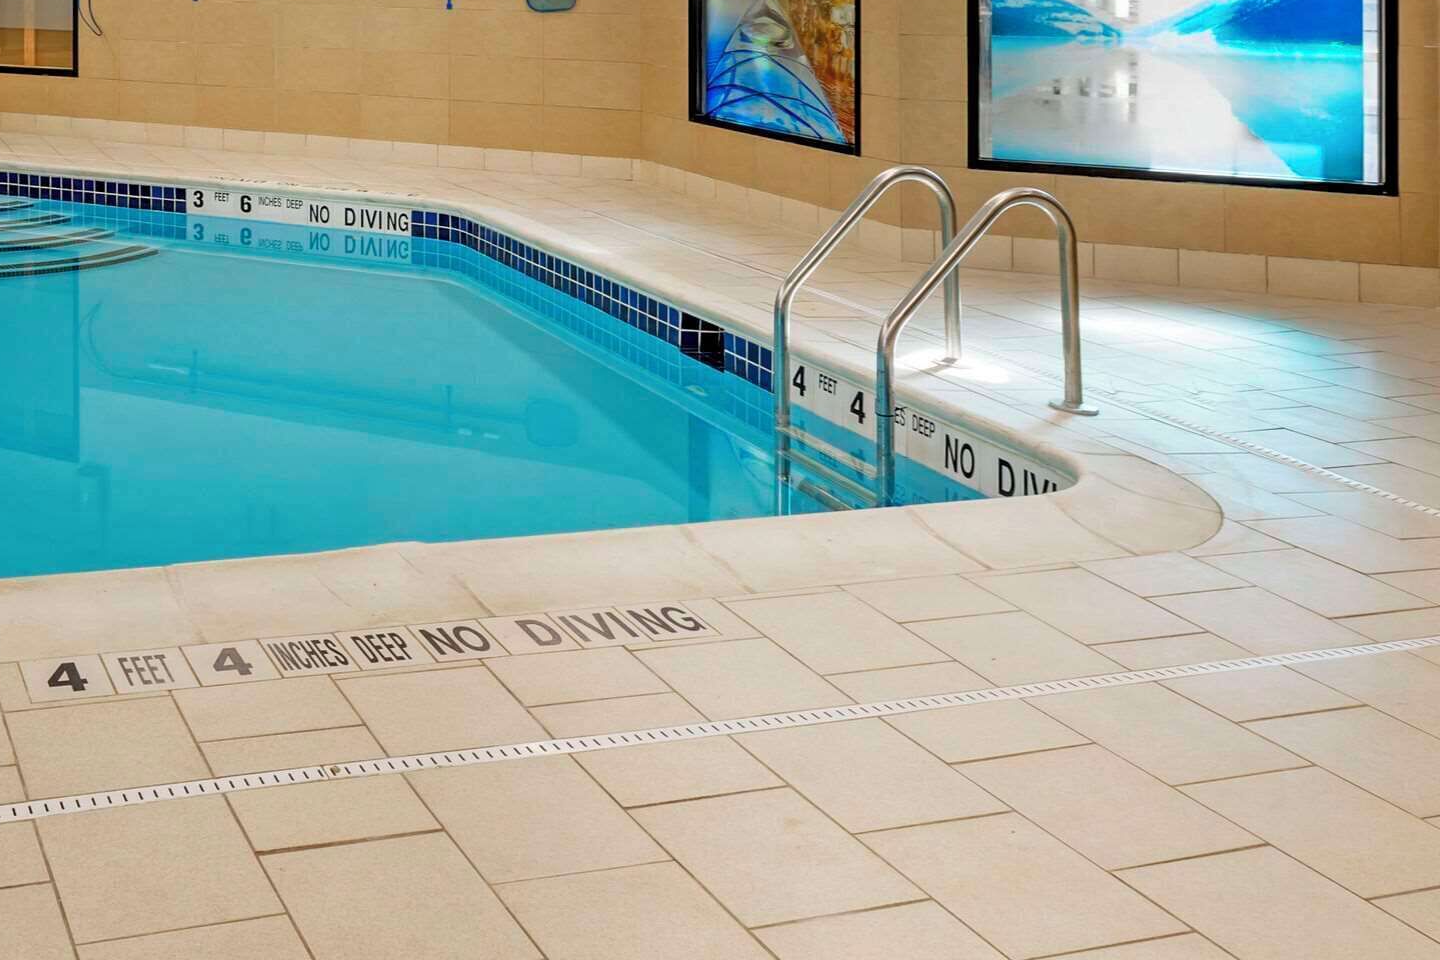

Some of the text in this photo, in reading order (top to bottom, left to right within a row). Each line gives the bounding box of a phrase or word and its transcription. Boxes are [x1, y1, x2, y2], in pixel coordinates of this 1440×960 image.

[193, 190, 409, 232] 3 FEET 6 INCHES DEEP NO DIVING
[792, 365, 806, 396] 4
[818, 373, 838, 395] FEET
[850, 391, 866, 425] 4
[912, 413, 936, 439] DEEP
[944, 434, 975, 478] NO
[47, 606, 707, 692] 4 FEET 4 INCHES DEEP NO DIVING
